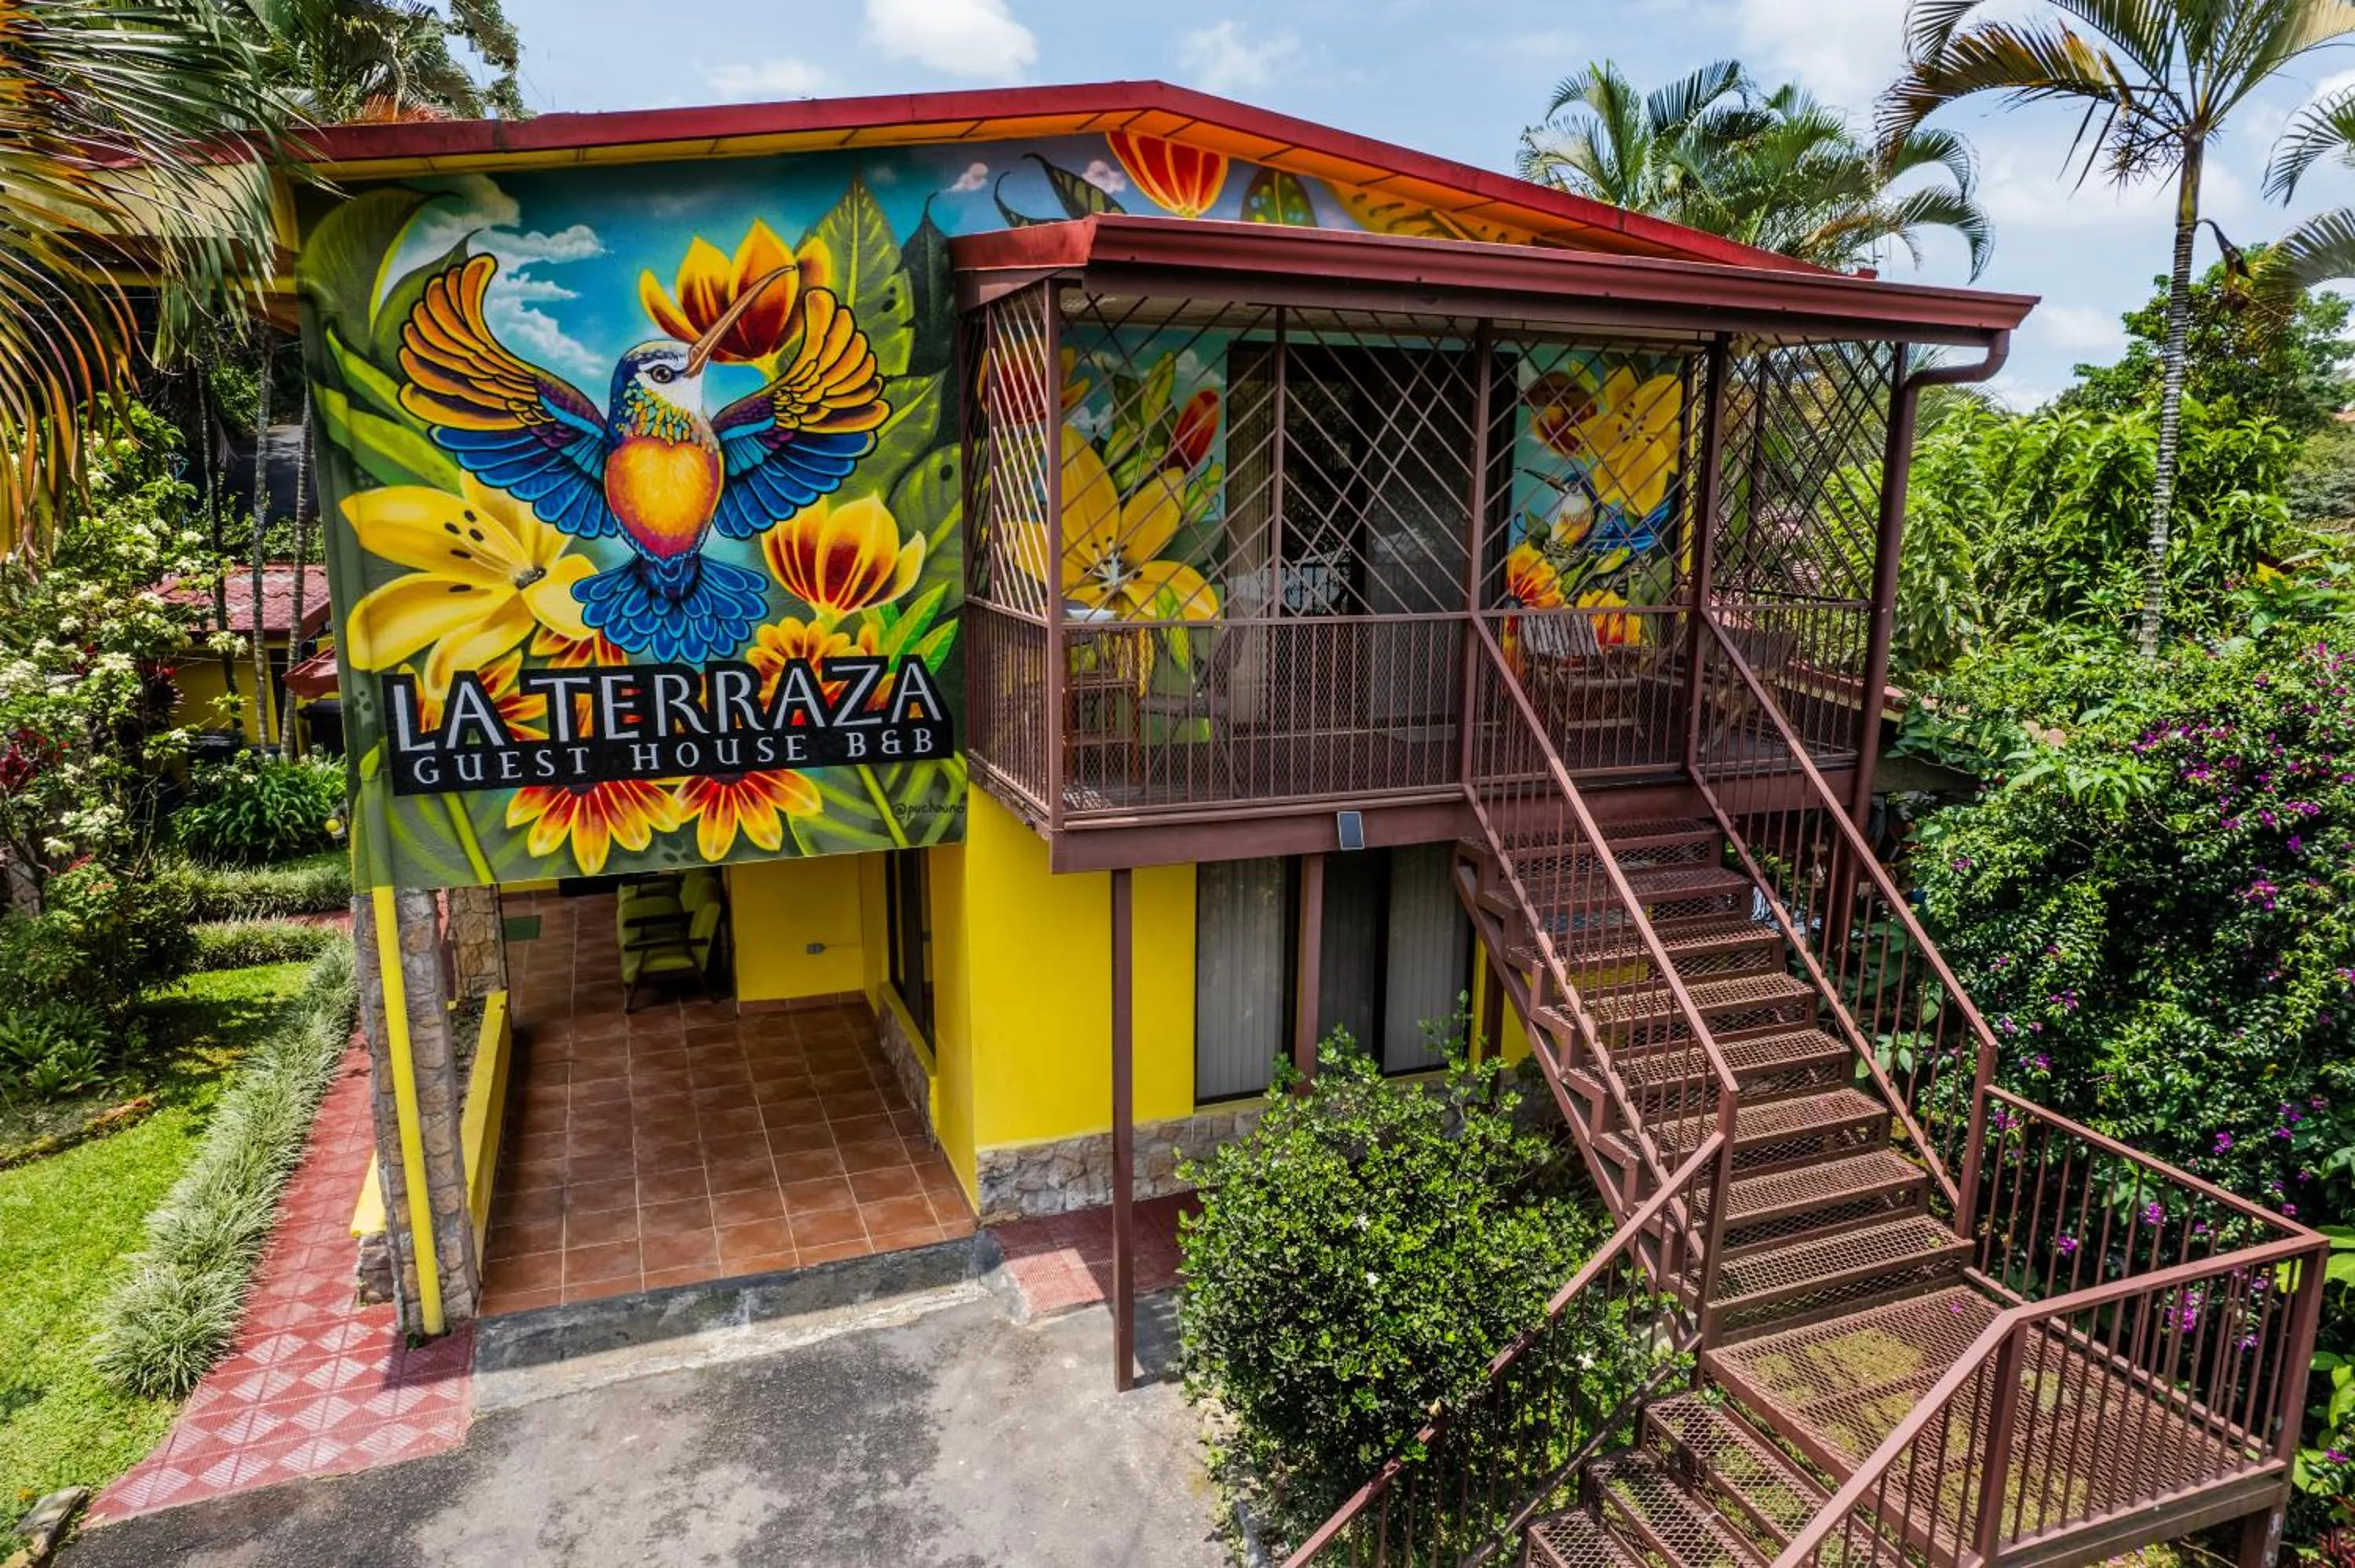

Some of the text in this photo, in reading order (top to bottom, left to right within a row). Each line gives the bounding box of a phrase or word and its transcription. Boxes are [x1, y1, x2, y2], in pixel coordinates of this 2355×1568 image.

[393, 662, 943, 752] LA TERRAZA
[413, 727, 933, 785] GUEST HOUSE B&B
